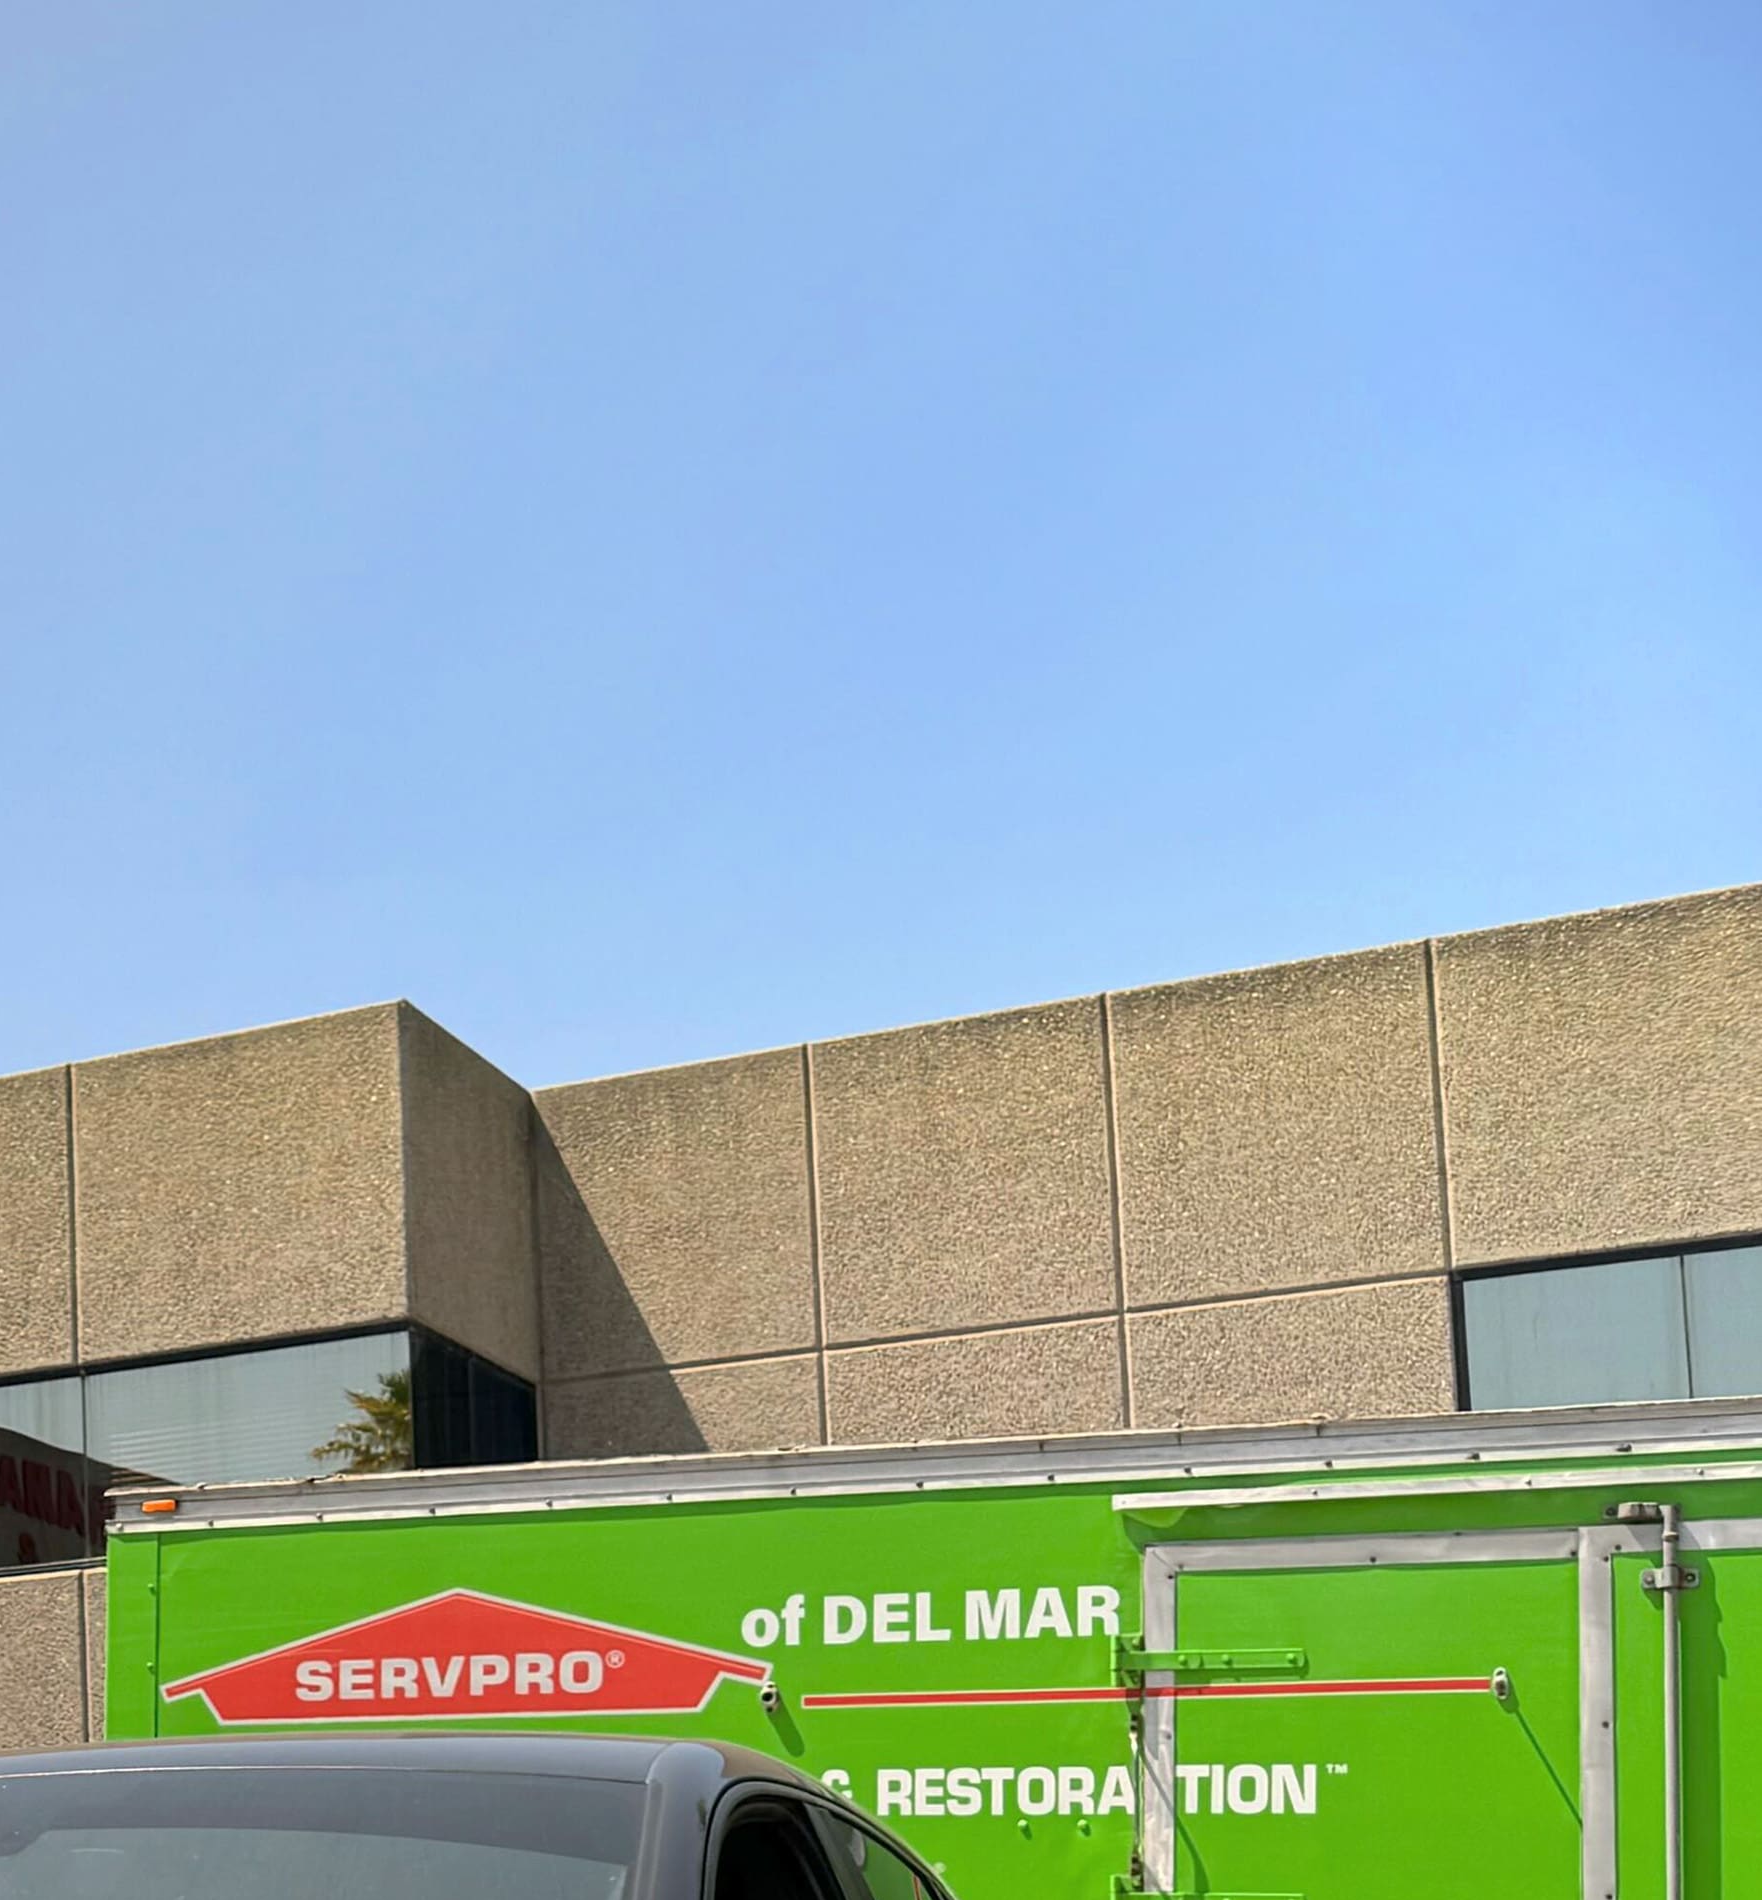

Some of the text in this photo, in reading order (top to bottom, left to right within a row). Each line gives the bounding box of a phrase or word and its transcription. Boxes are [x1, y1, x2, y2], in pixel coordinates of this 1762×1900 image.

[741, 1585, 1121, 1647] of DEL MAR
